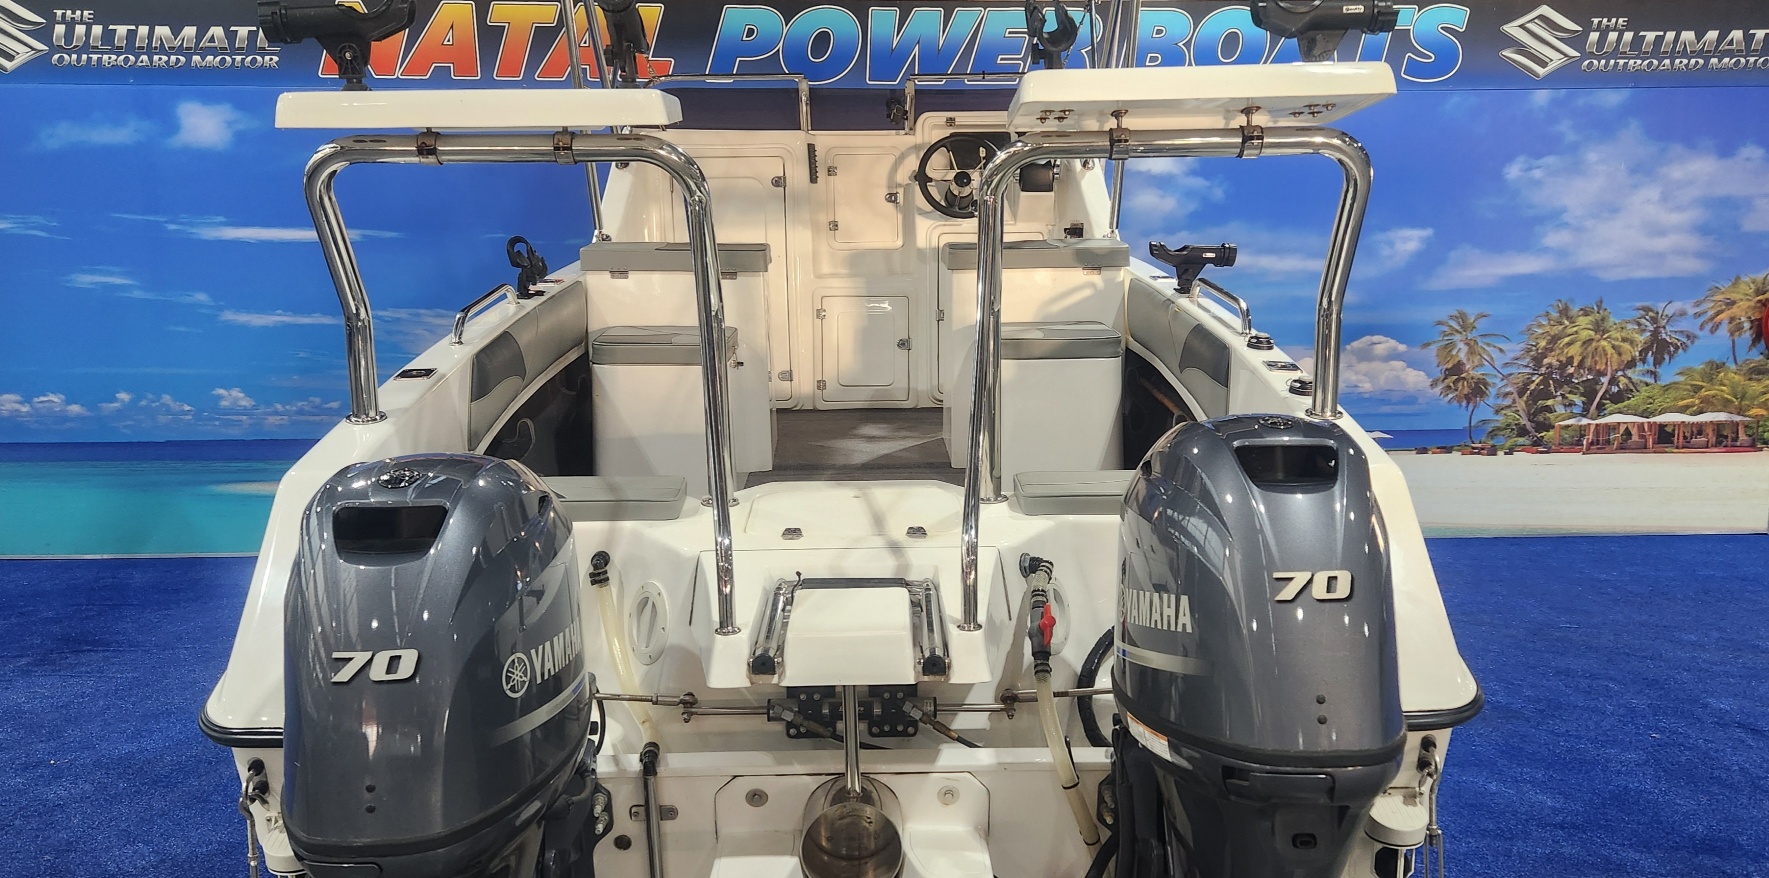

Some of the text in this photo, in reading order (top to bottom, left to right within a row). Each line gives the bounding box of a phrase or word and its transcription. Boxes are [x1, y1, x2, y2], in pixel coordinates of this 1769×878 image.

[53, 9, 94, 22] THE
[1590, 17, 1629, 30] THE
[705, 4, 1104, 85] POWER
[51, 53, 280, 69] OUTBOARD MOTOR
[1581, 58, 1702, 72] OUTBOARD
[1273, 570, 1352, 601] 70
[1126, 588, 1193, 633] YAMAHA
[330, 649, 419, 683] 70
